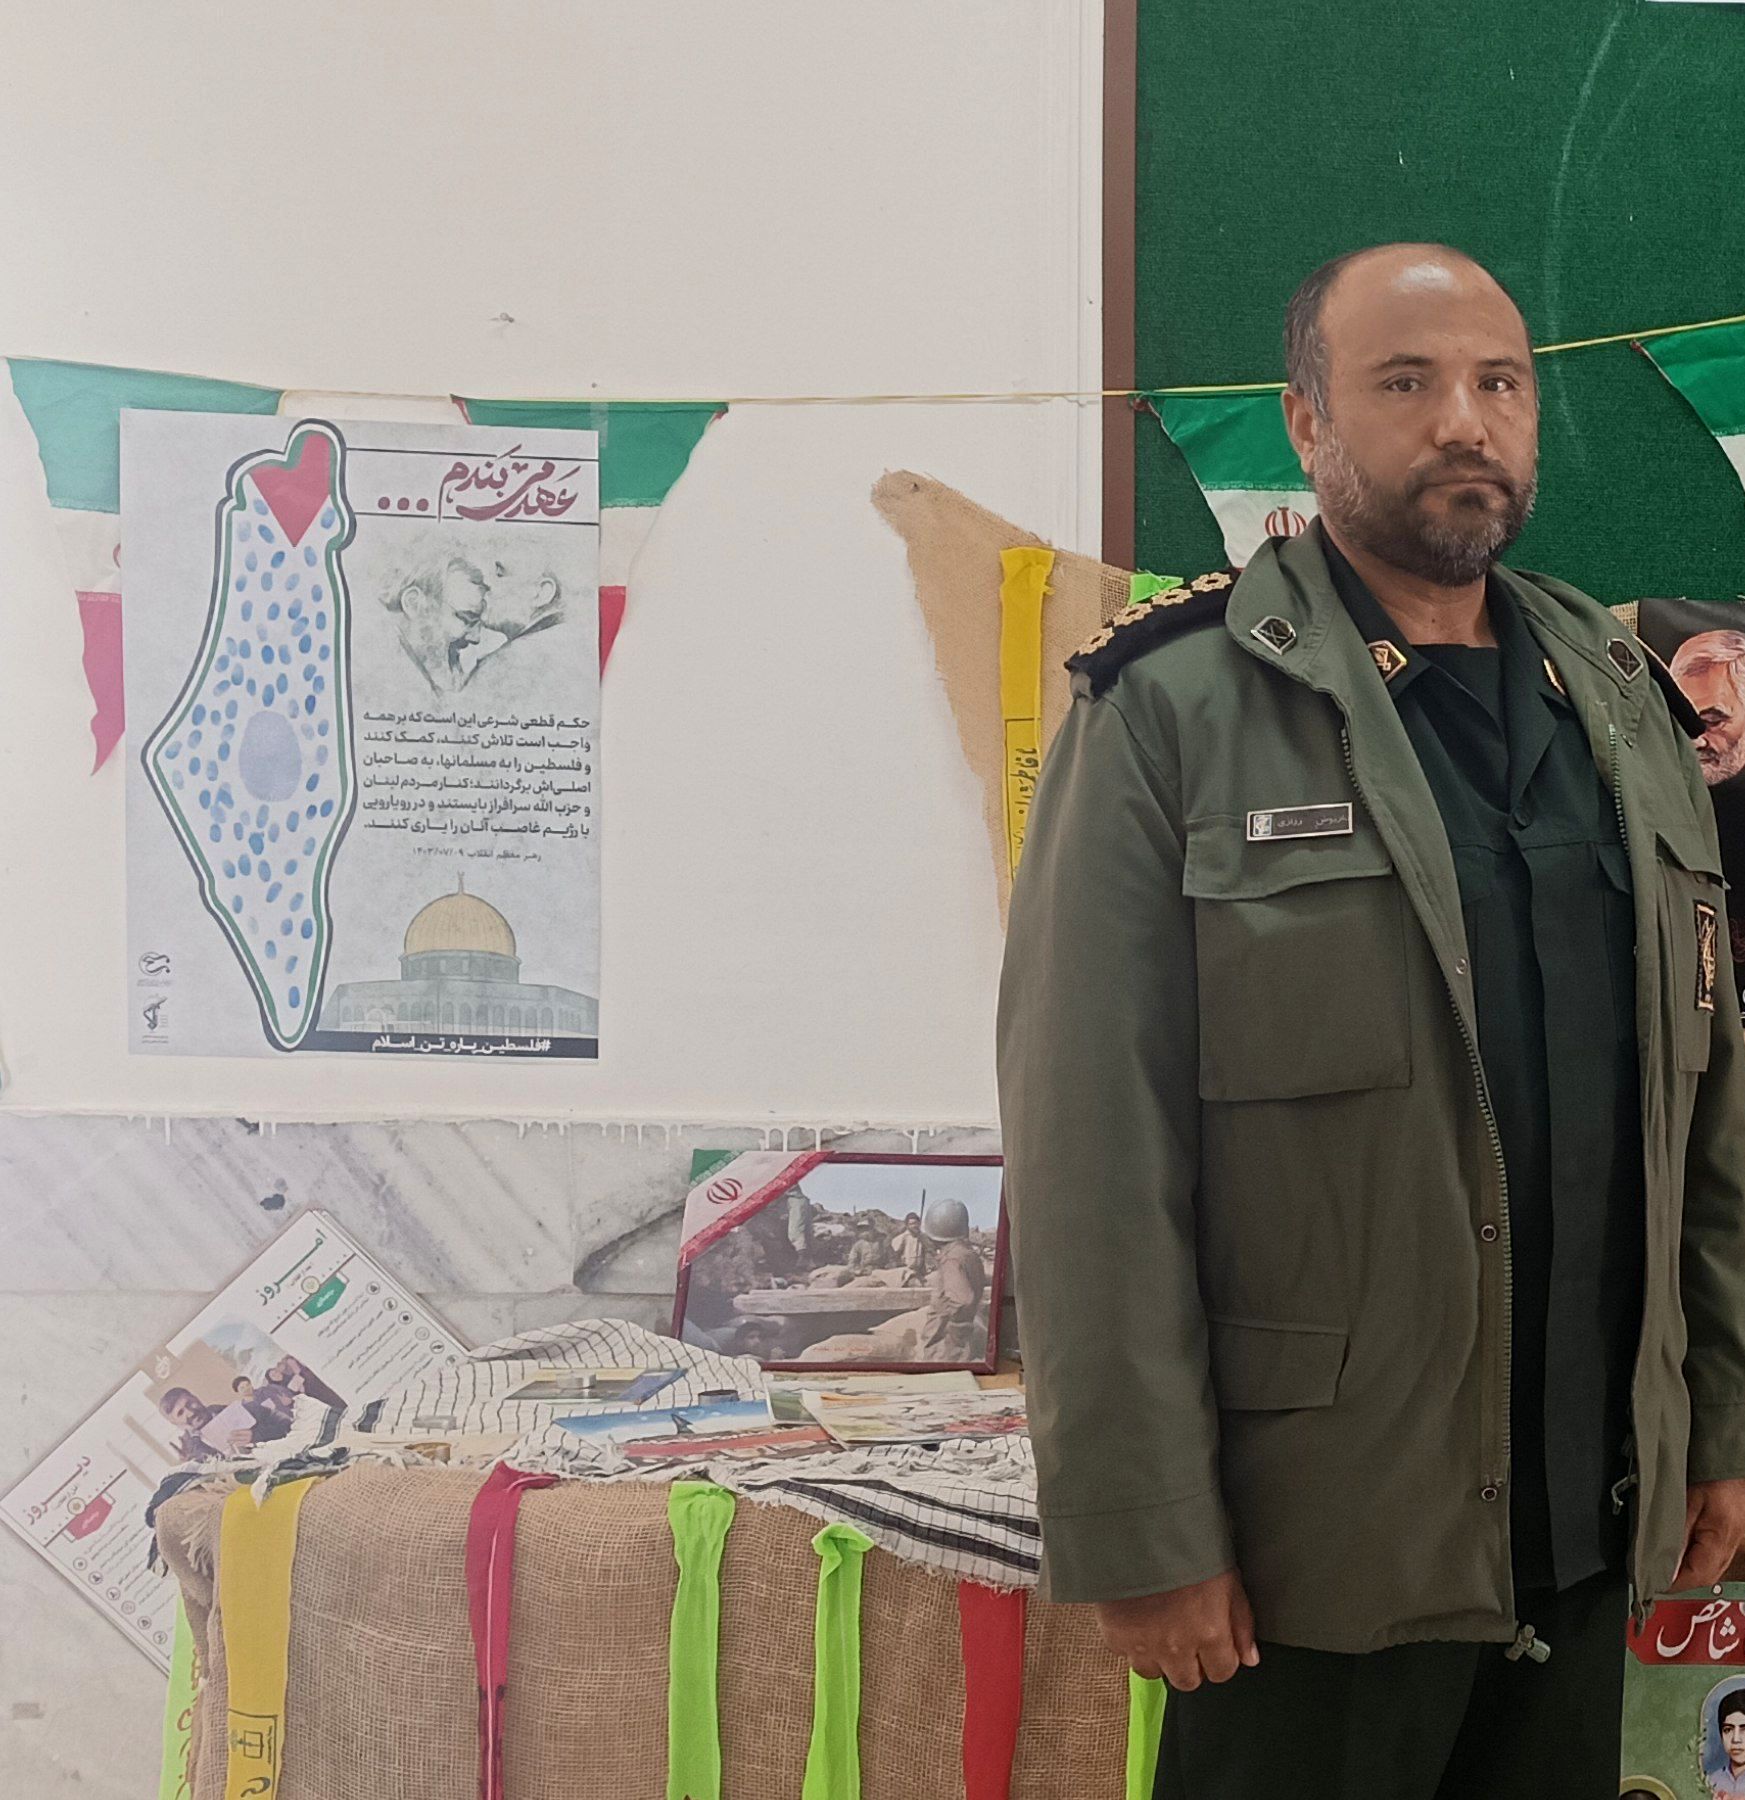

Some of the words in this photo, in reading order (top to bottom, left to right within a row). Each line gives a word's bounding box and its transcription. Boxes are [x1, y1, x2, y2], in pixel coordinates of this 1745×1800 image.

[363, 711, 399, 722] همه
[394, 712, 407, 726] بر
[408, 711, 423, 723] که
[423, 711, 456, 724] است
[457, 713, 476, 728] این
[477, 716, 519, 728] شرعی
[520, 713, 555, 730] قطعی
[556, 716, 590, 732] حکم
[363, 730, 393, 742] کنند
[394, 731, 436, 743] کمک
[481, 734, 514, 750] تلاش
[515, 735, 545, 748] است
[547, 736, 591, 752] واجب
[363, 752, 419, 767] صاحبان
[421, 755, 434, 767] به
[499, 758, 512, 771] به
[514, 757, 522, 772] را
[524, 757, 582, 774] فلسطین
[585, 763, 591, 776] و
[363, 774, 400, 788] لبنان
[400, 779, 439, 790] مردم
[438, 777, 470, 791] کنار
[363, 794, 412, 811] رویارویی
[413, 798, 426, 812] در
[437, 796, 487, 813] بایستند
[488, 798, 531, 814] سرافراز
[533, 796, 552, 813] الله
[555, 804, 582, 817] حزب
[584, 804, 591, 817] و
[410, 818, 448, 835] یاری
[450, 819, 458, 835] را
[460, 817, 490, 834] آنان
[490, 820, 541, 837] غاصب
[542, 823, 579, 839] رژیم
[580, 823, 590, 839] با
[25, 1455, 92, 1527] دیروز
[1655, 1584, 1741, 1661] شاخص
